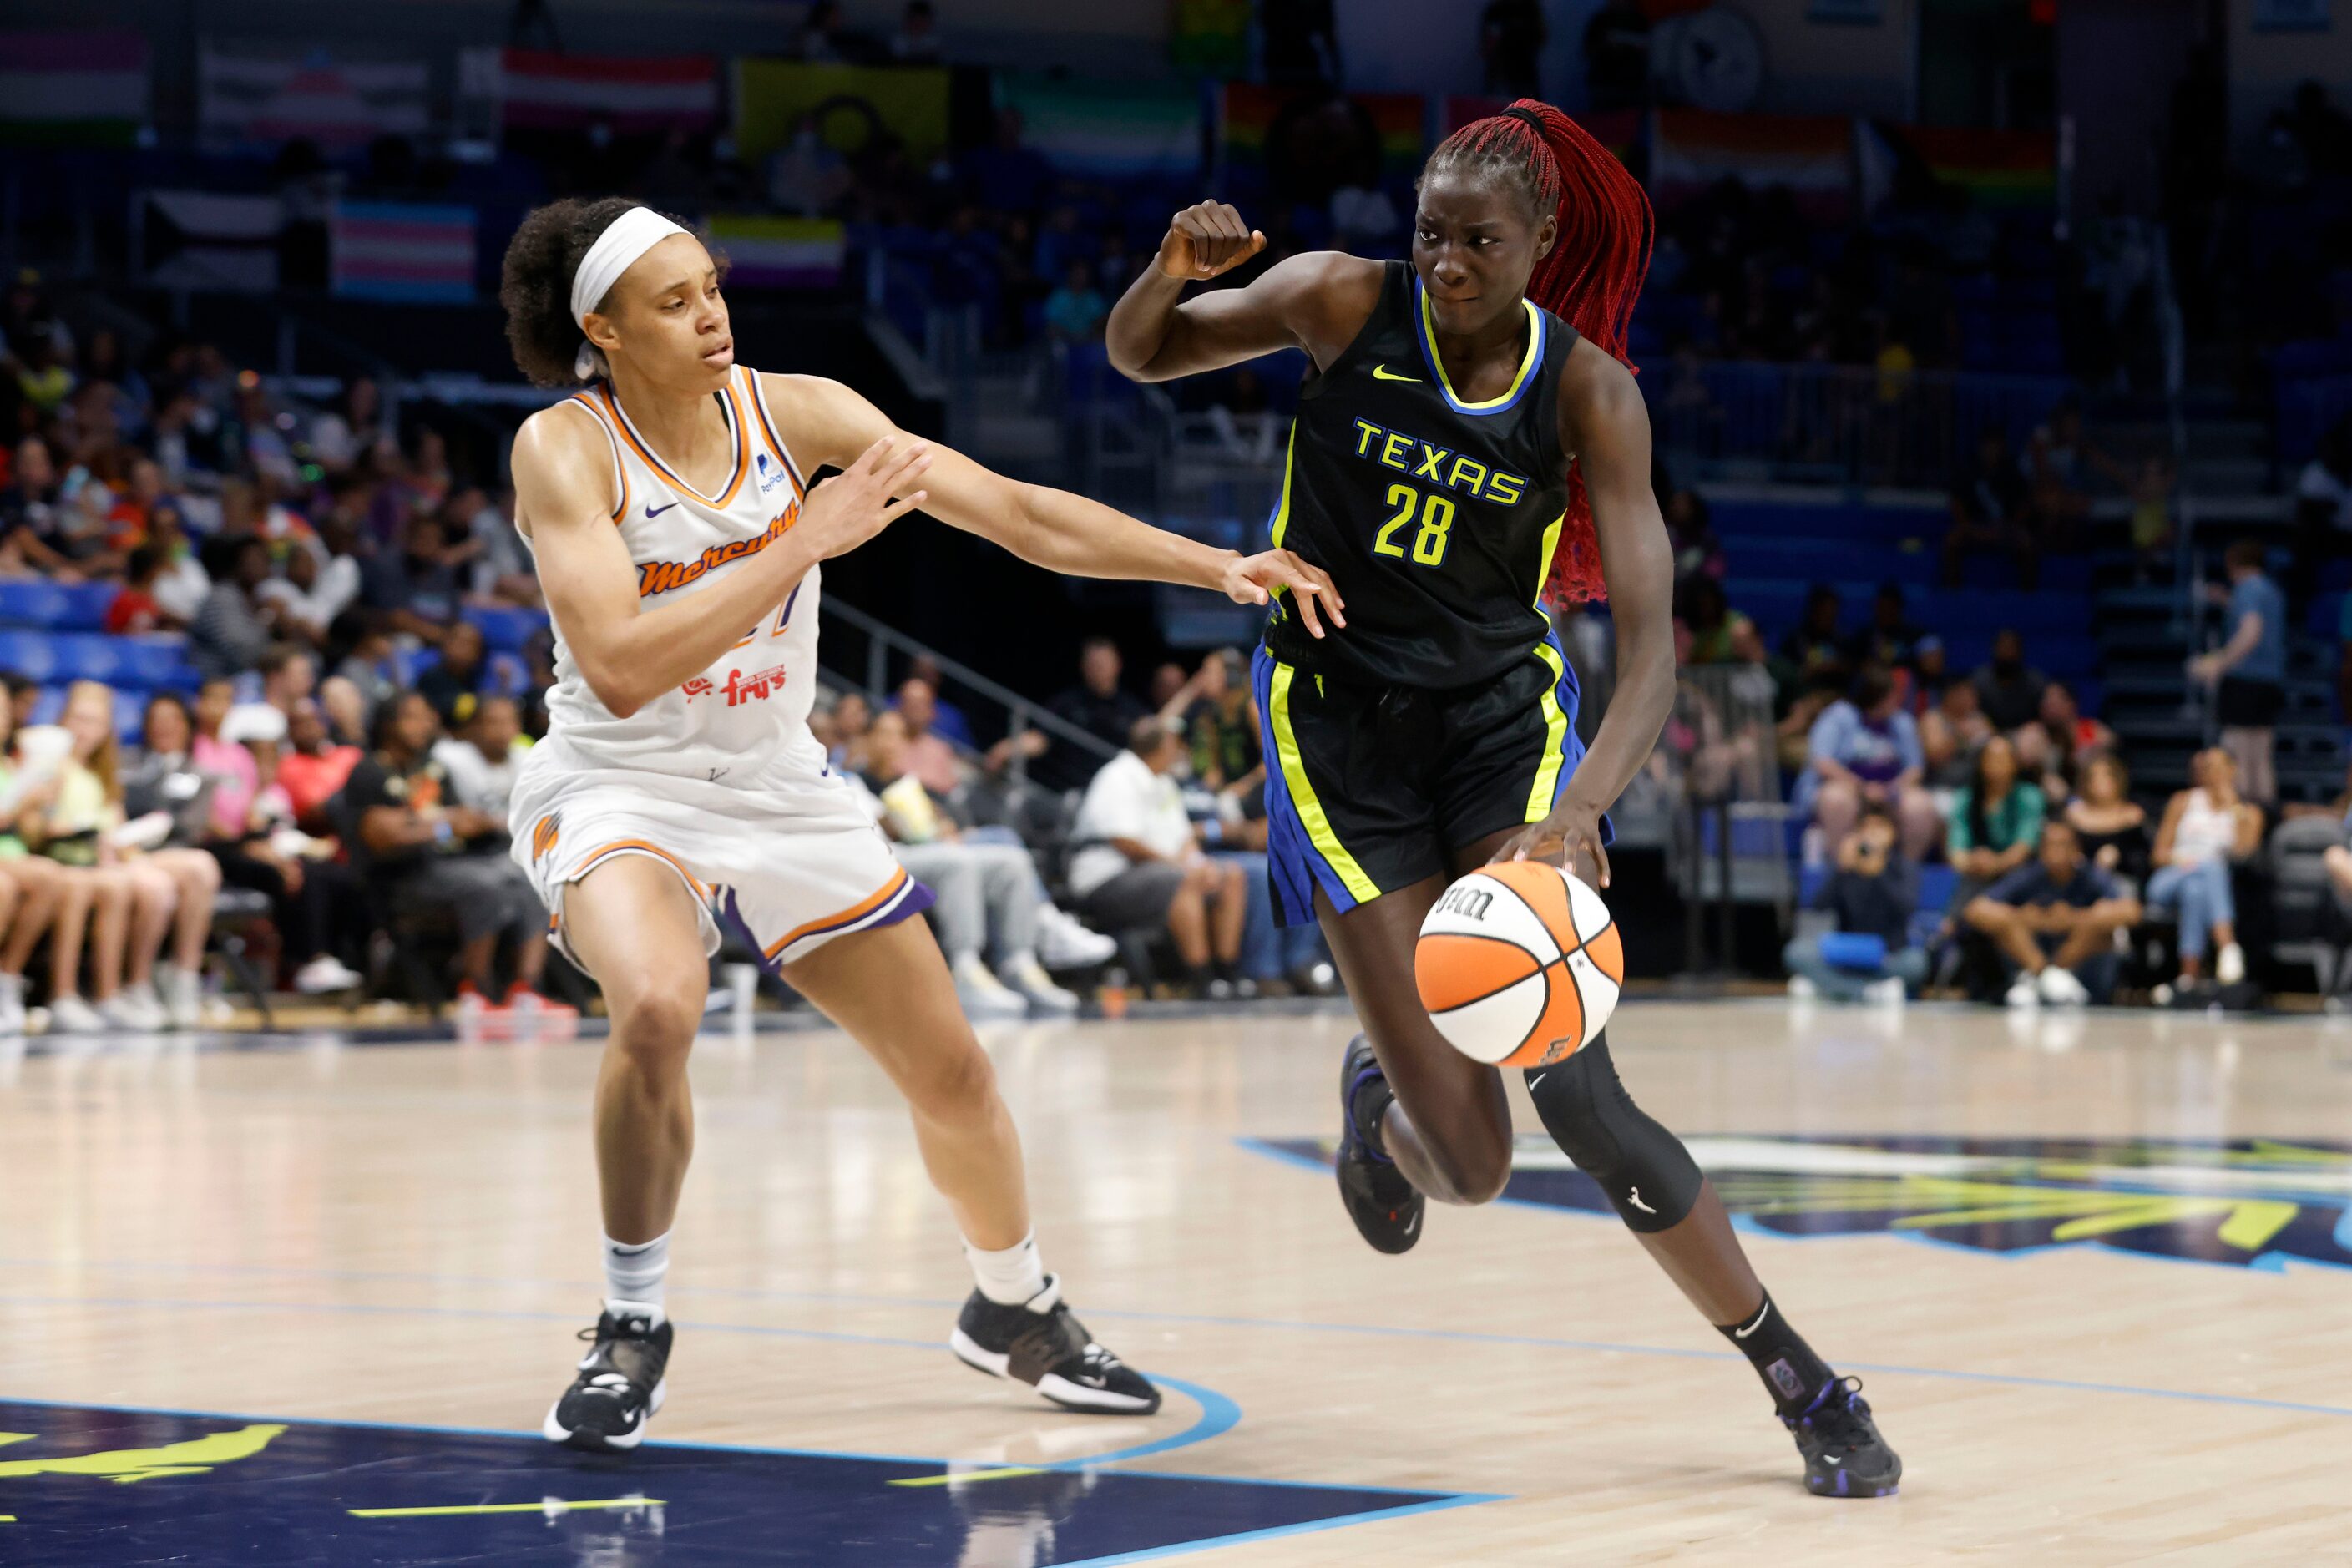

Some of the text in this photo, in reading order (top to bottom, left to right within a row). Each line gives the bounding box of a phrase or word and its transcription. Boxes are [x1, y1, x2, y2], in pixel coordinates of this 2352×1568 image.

[761, 470, 786, 494] PayPal
[1353, 416, 1529, 506] TEXAS
[635, 498, 800, 597] Mercury
[1372, 482, 1458, 568] 28
